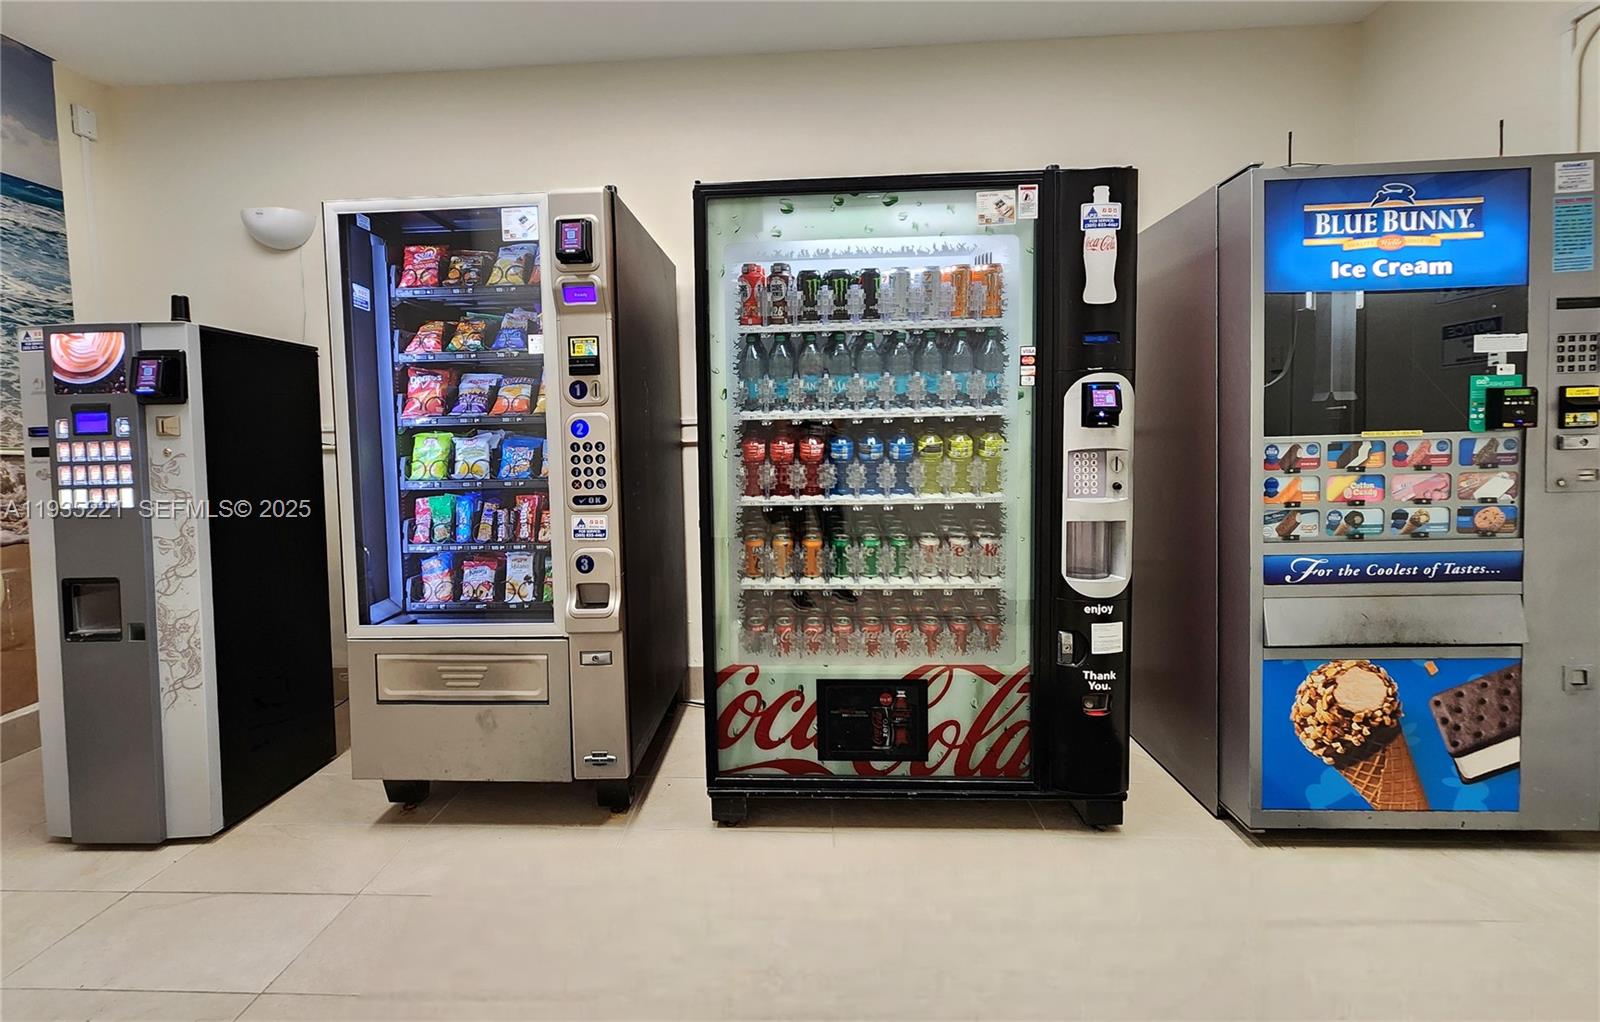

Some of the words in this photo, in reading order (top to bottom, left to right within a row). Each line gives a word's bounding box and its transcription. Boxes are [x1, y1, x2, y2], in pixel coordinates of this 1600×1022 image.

[1315, 212, 1377, 236] BLUE
[1383, 208, 1474, 232] BUNNY
[1332, 261, 1366, 279] Ice
[1372, 259, 1453, 277] Cream
[1285, 557, 1333, 583] For
[1338, 563, 1360, 577] the
[1366, 562, 1418, 576] Coolest
[1423, 562, 1439, 579] of
[1443, 562, 1501, 575] Tastes...
[1083, 603, 1114, 615] enjoy
[1082, 670, 1117, 680] Thank
[1088, 681, 1112, 691] You.
